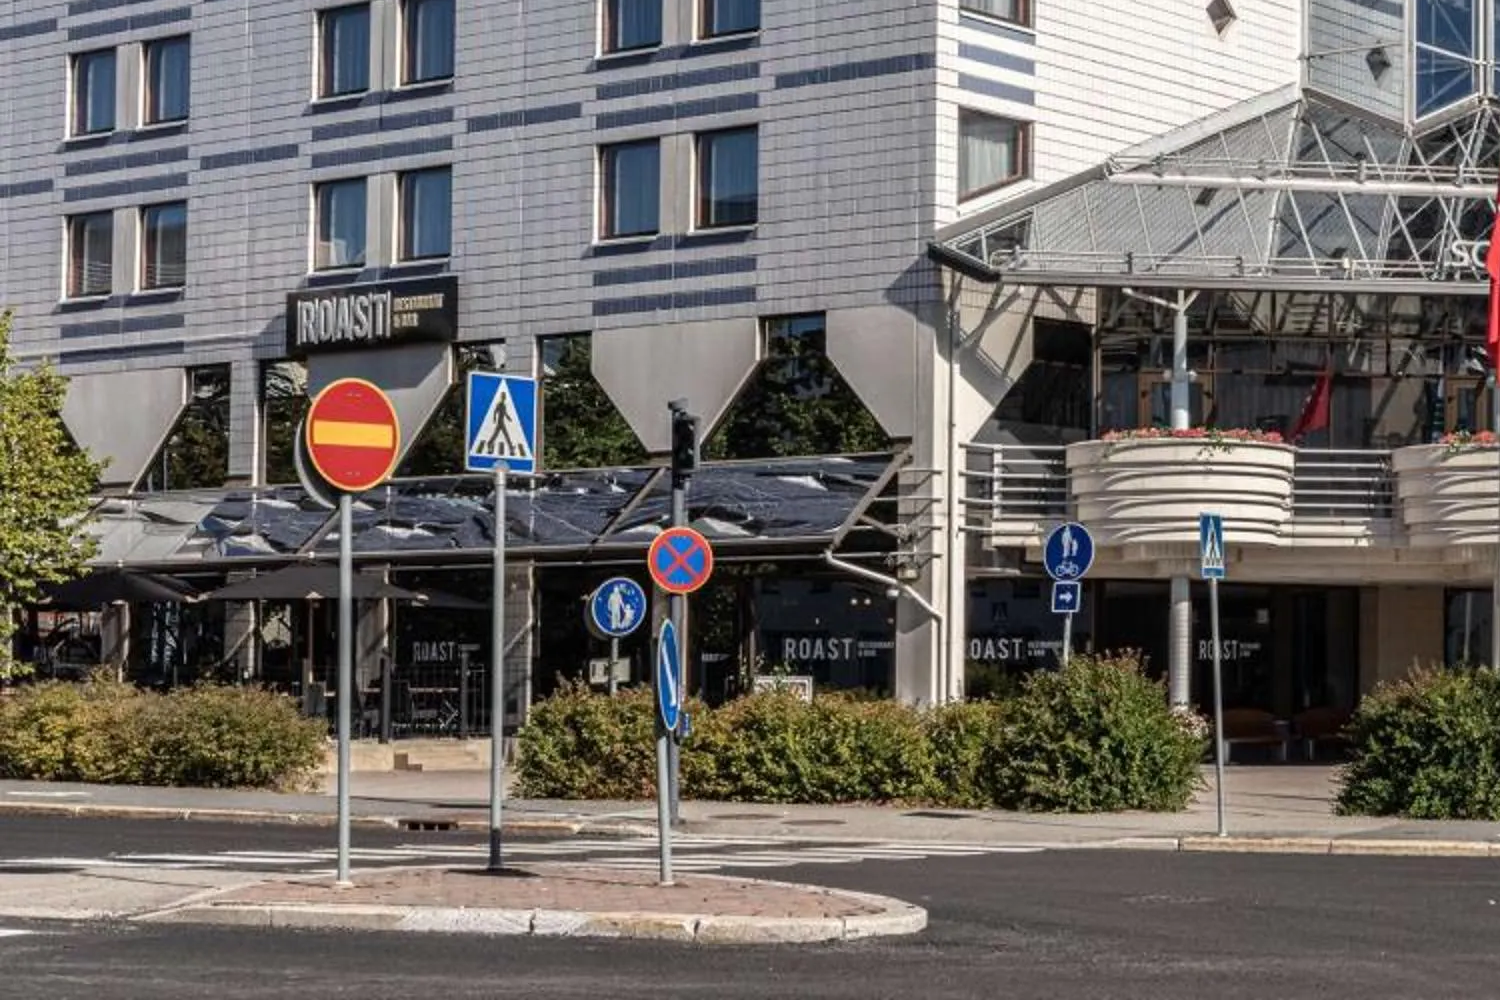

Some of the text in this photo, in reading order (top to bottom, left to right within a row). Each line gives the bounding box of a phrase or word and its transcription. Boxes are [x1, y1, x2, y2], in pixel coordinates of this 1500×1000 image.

[412, 641, 455, 662] ROAST
[784, 637, 854, 660] ROAST
[970, 637, 1023, 660] OAST
[1199, 640, 1238, 660] ROST
